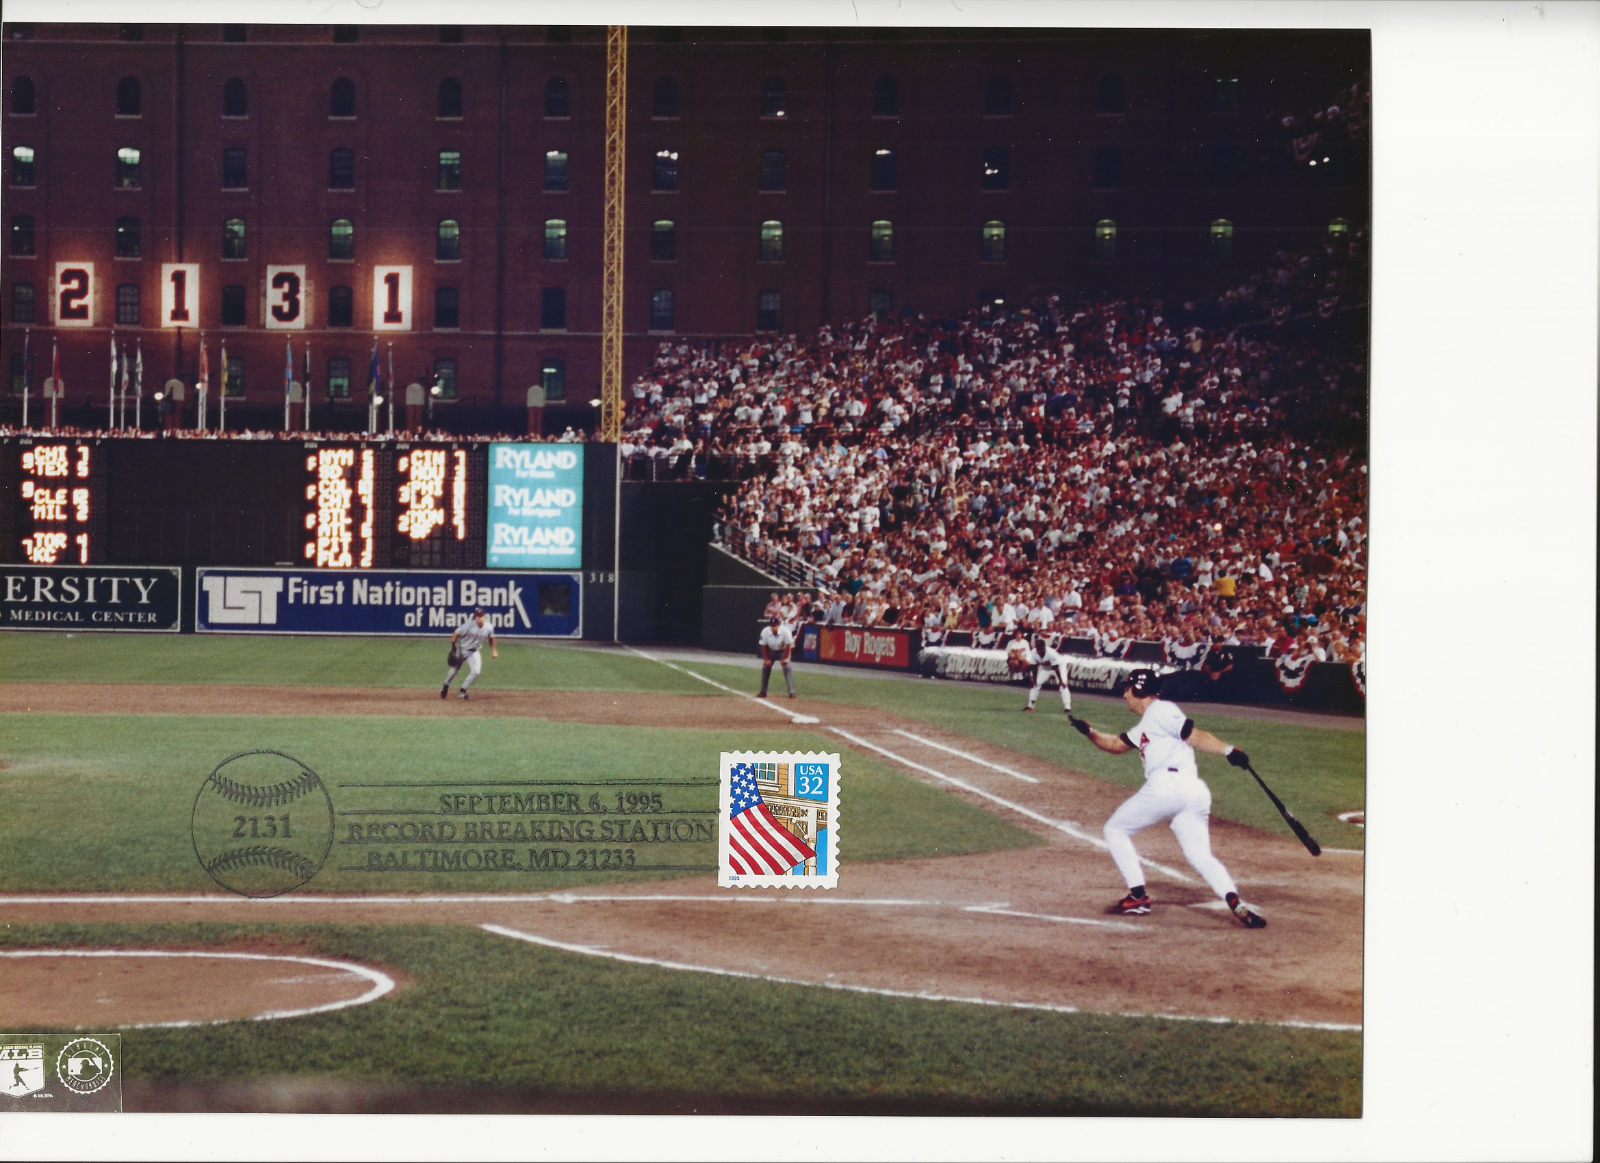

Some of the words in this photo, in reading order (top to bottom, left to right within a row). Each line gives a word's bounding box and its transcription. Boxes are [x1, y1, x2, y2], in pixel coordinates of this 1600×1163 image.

[60, 269, 89, 320] 2
[170, 270, 189, 322] 1
[271, 272, 300, 323] 3
[383, 272, 403, 324] 1
[34, 446, 68, 461] CHI
[319, 449, 354, 466] NYM
[410, 449, 446, 466] CIN
[495, 447, 577, 470] RYLAND
[35, 460, 69, 476] TEX
[34, 488, 68, 504] CLE
[494, 484, 576, 508] RYLAND
[34, 504, 68, 520] MIL
[33, 532, 67, 549] TOR
[493, 522, 575, 546] RYLAND
[33, 547, 56, 563] KC
[288, 577, 345, 605] First
[353, 578, 454, 606] National
[91, 611, 158, 623] CENTER
[404, 606, 425, 628] of
[429, 607, 515, 629] Maryand
[844, 630, 862, 659] Roy
[863, 632, 896, 662] Rogers
[800, 765, 823, 776] USA
[799, 776, 823, 795] 32
